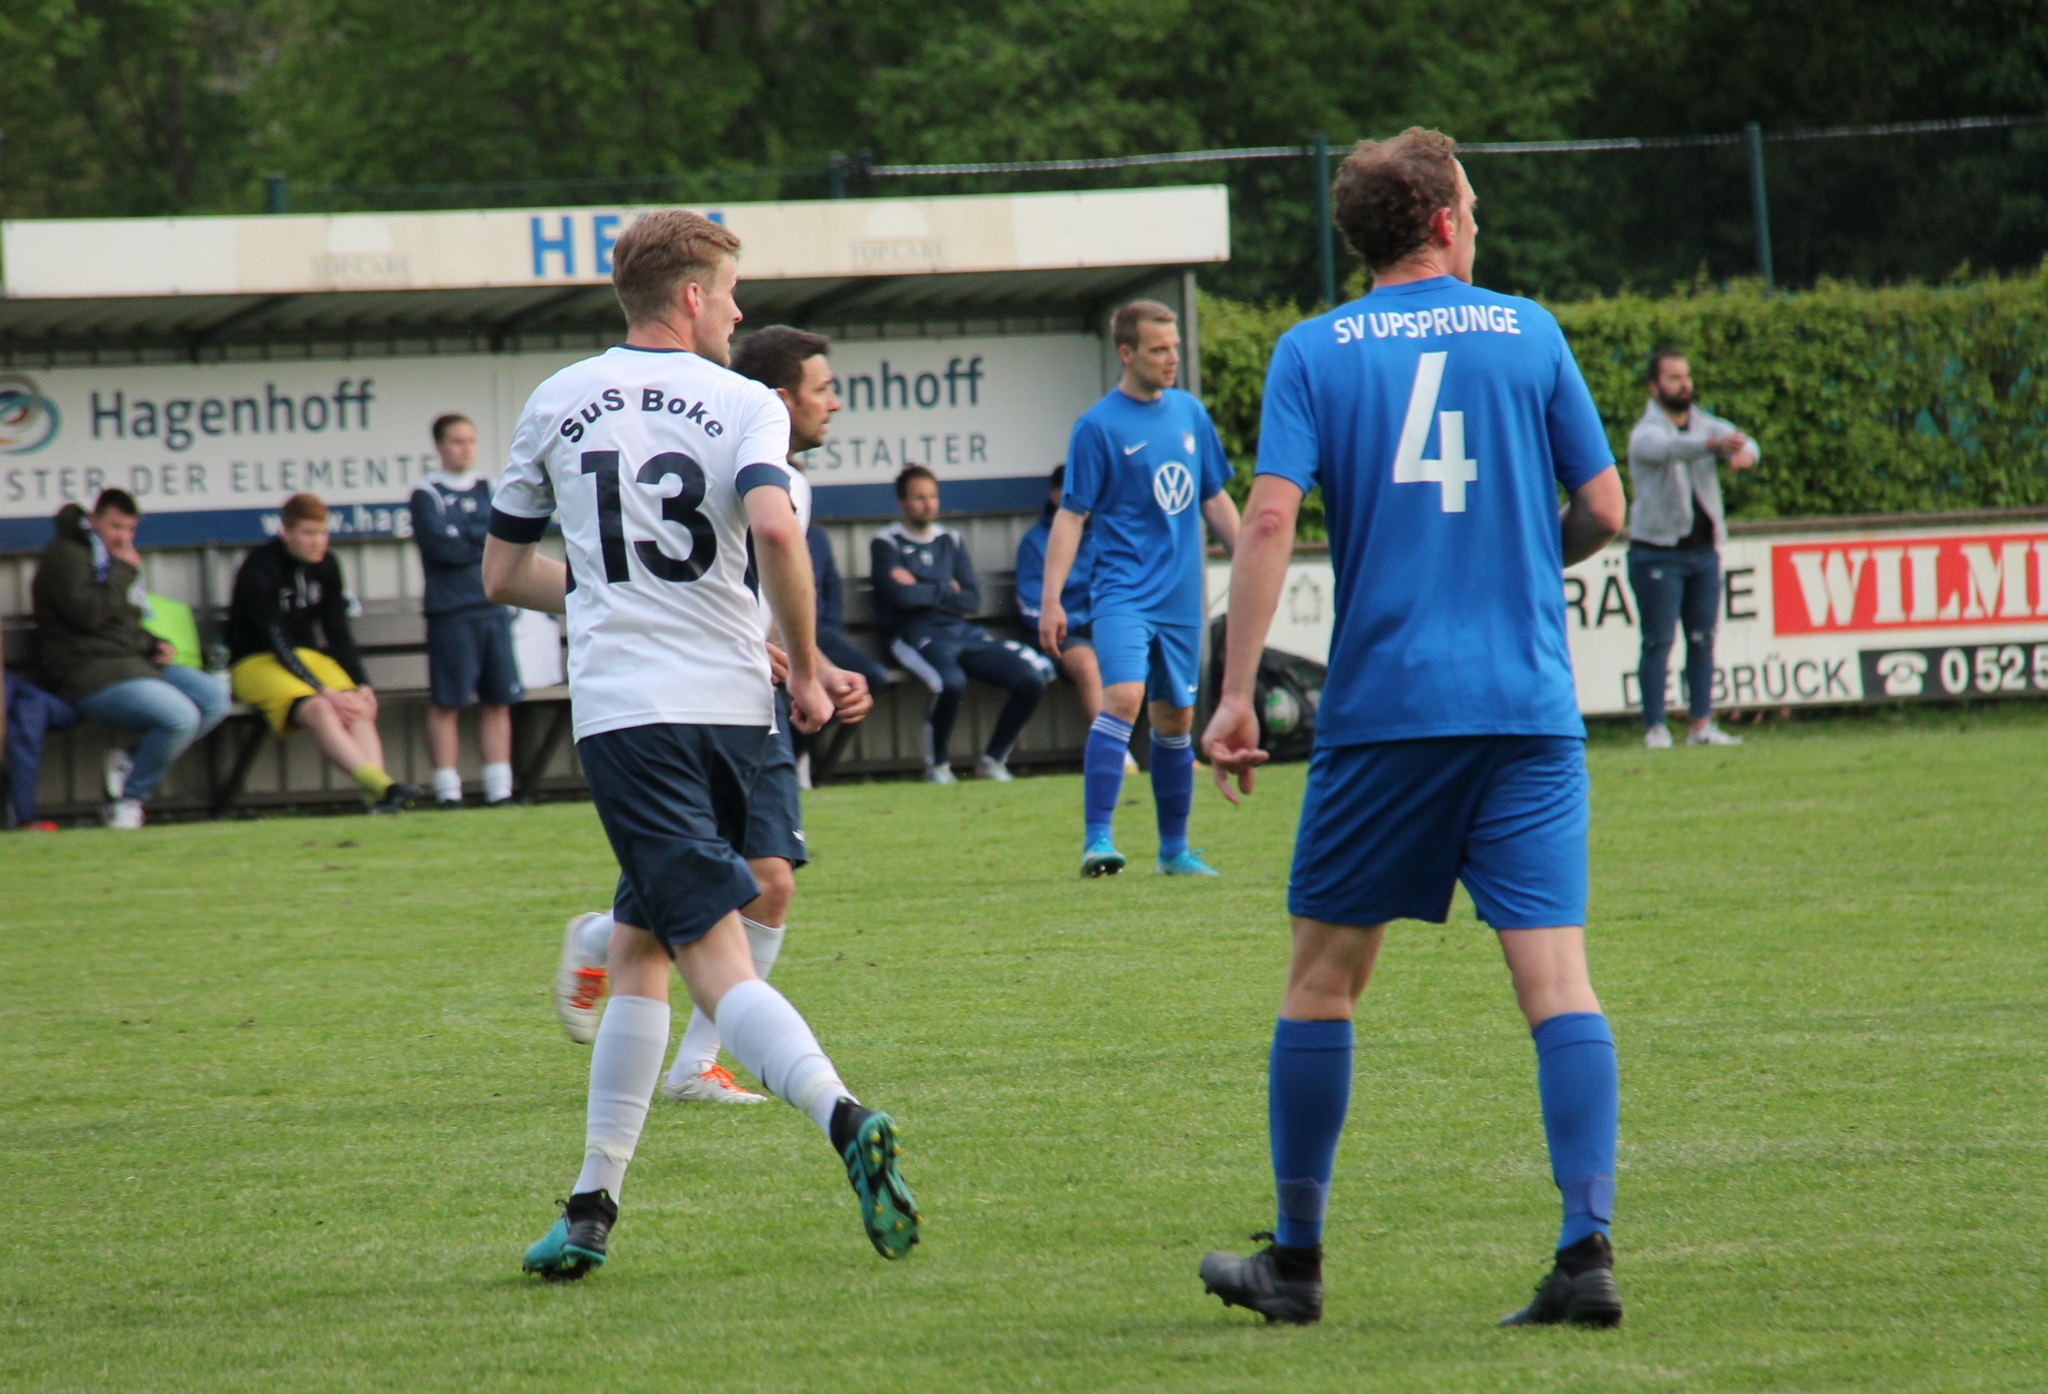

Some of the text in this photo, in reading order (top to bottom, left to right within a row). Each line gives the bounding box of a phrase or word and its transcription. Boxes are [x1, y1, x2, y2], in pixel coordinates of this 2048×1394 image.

[1334, 305, 1521, 344] SV UPSPRUNGE
[91, 377, 375, 452] Hagenhoff
[560, 388, 724, 443] SuS Boke
[1393, 351, 1477, 513] 4
[131, 463, 207, 496] DER
[231, 454, 437, 492] ELEMENTE
[1154, 461, 1194, 515] VW
[261, 504, 414, 539] ww.hag
[581, 450, 717, 584] 13
